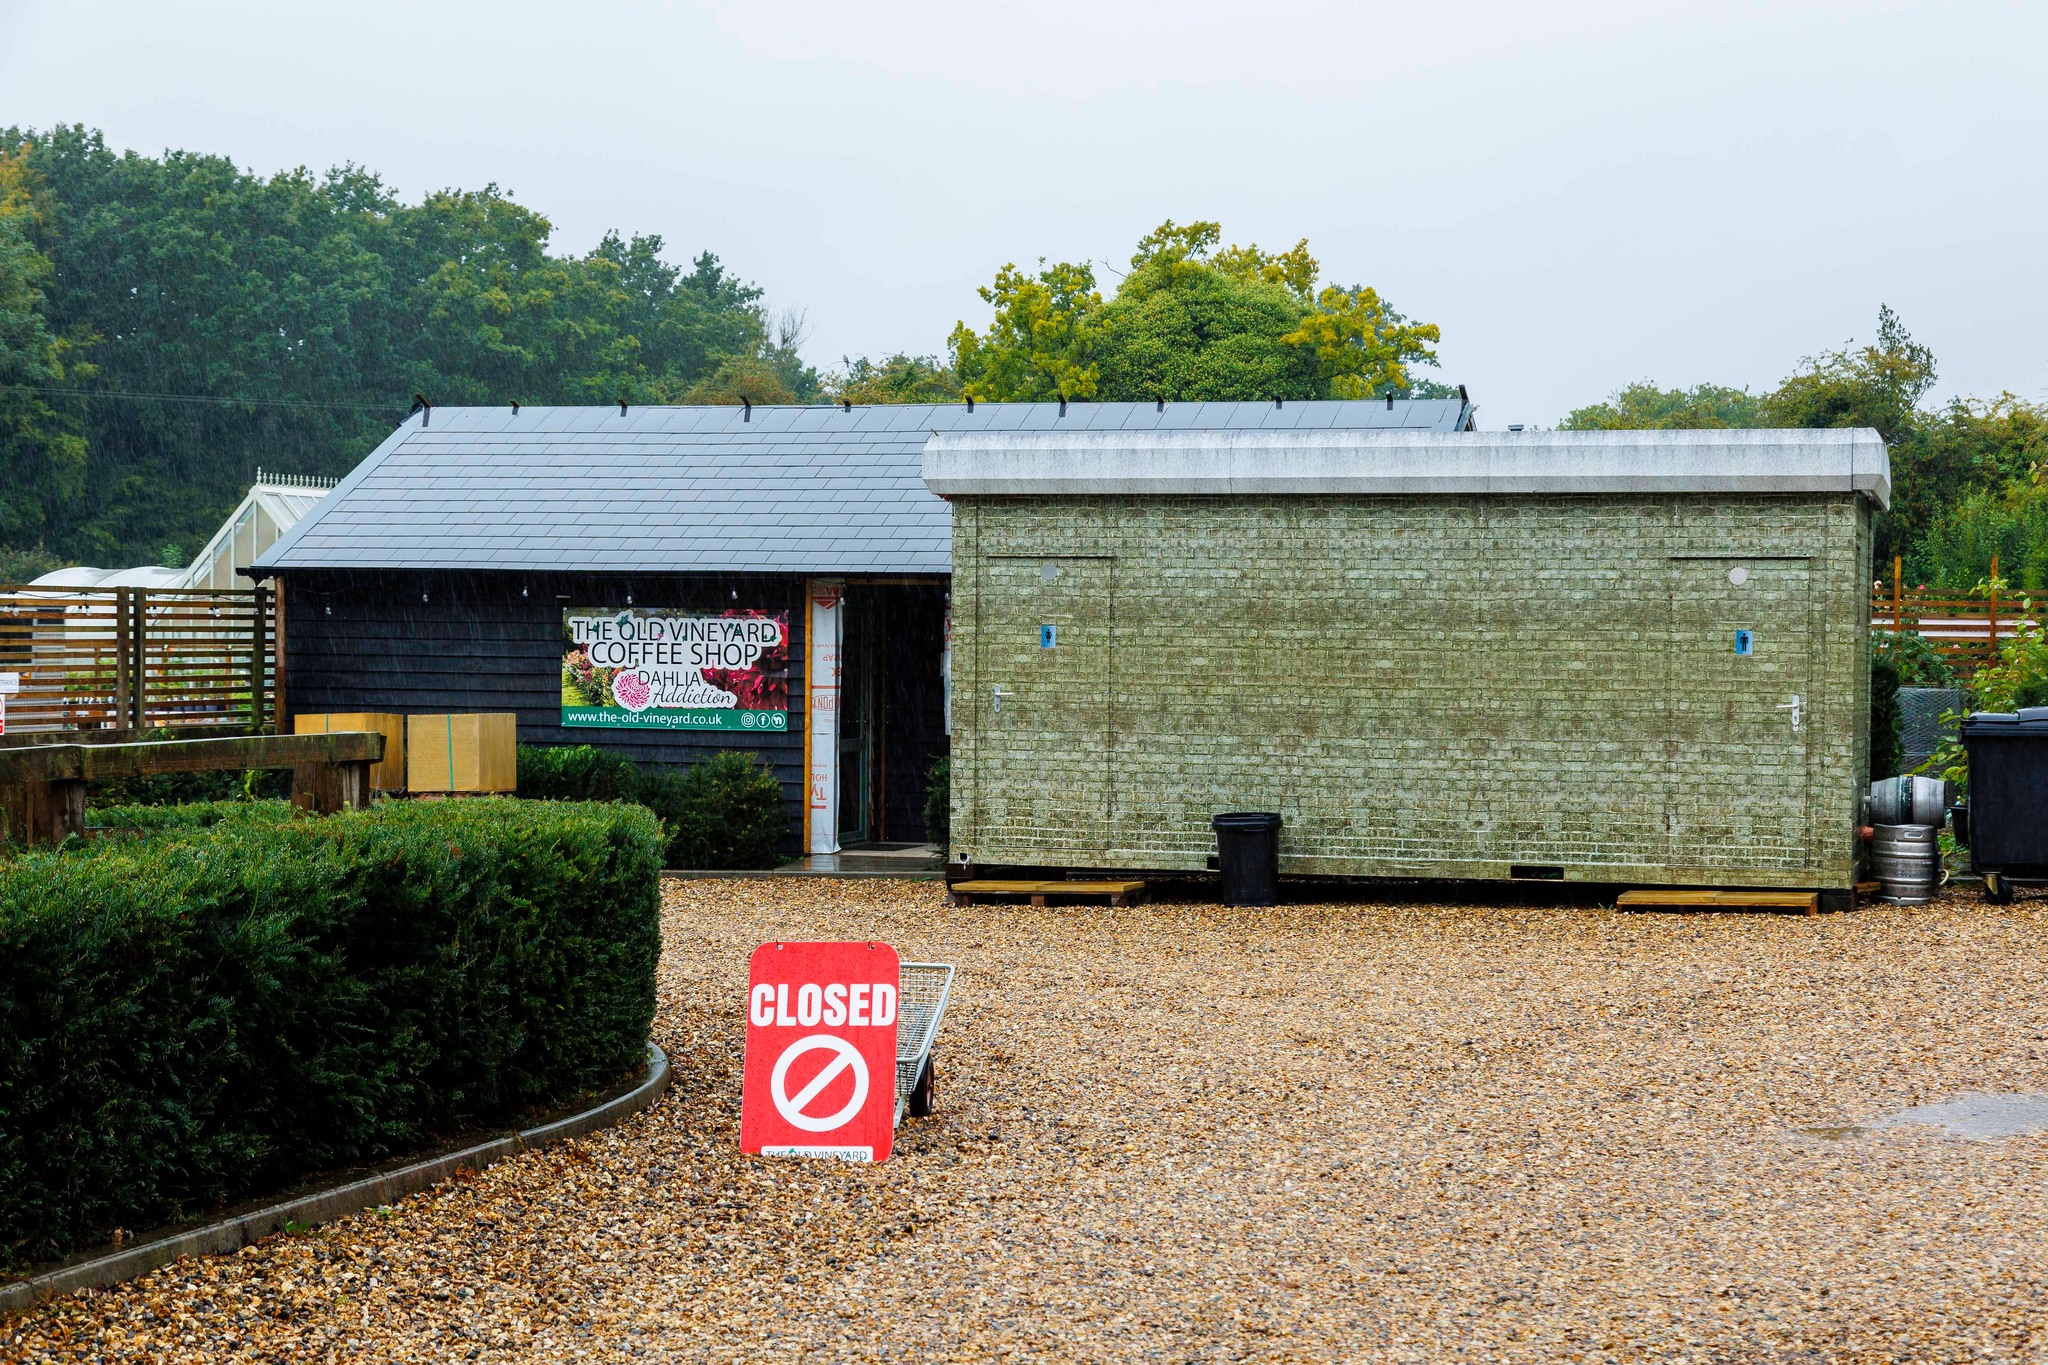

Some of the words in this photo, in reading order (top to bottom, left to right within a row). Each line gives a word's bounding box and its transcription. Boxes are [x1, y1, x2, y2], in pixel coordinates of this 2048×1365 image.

[572, 620, 613, 640] THE
[619, 621, 664, 642] OLD
[669, 622, 777, 643] VINEYARD
[591, 641, 683, 665] COFFEE
[690, 643, 758, 666] SHOP
[638, 670, 701, 687] DAHLIA
[652, 685, 734, 704] Addiction
[568, 711, 722, 727] www.the-old-vineyard.co.uk
[750, 983, 897, 1027] CLOSED
